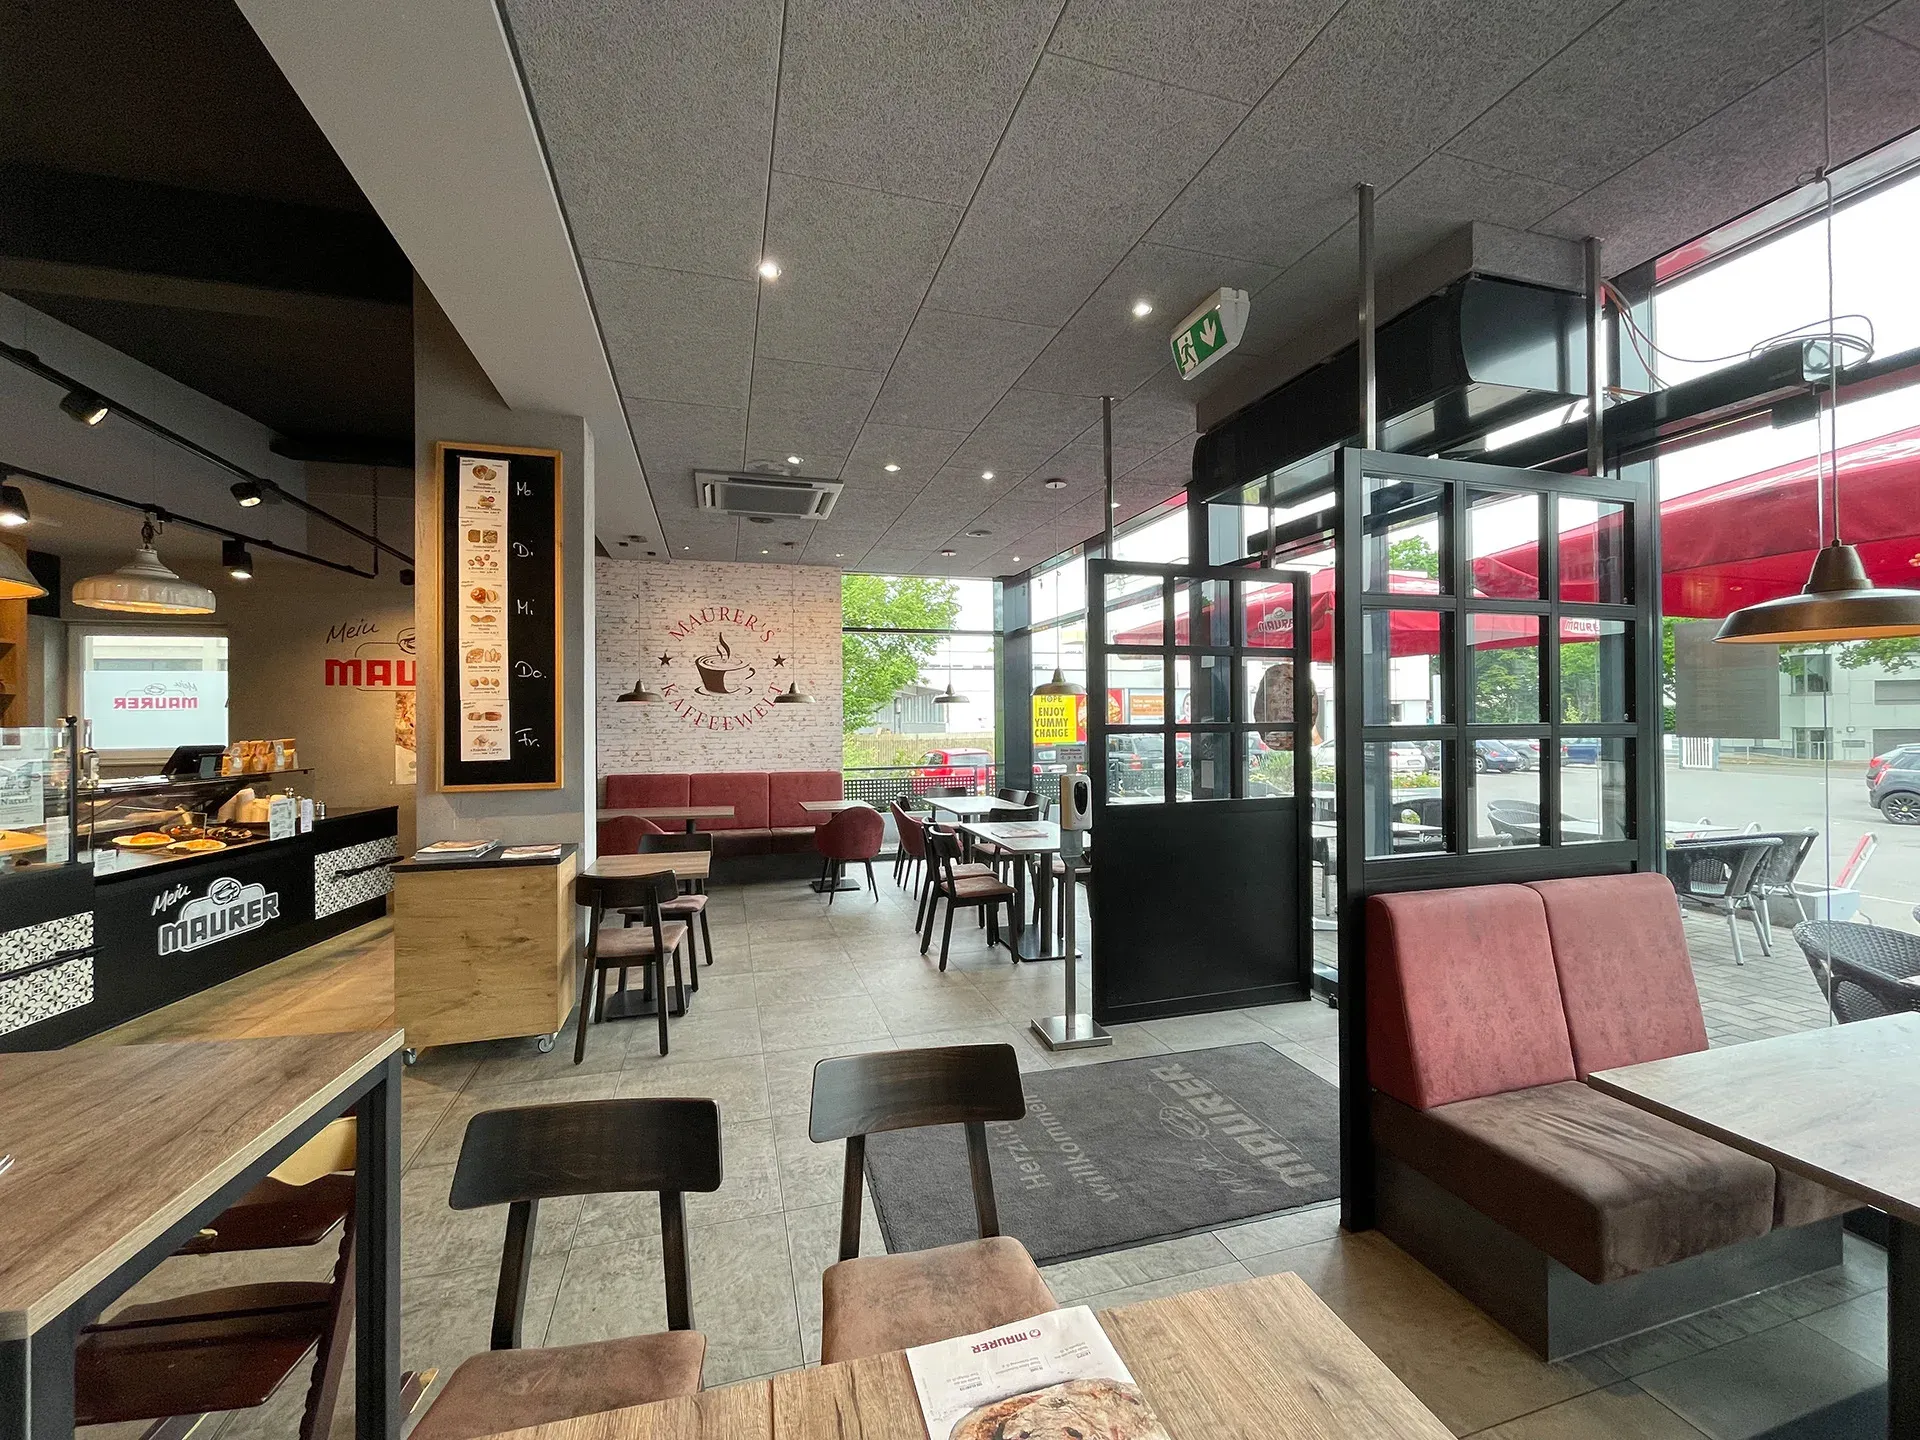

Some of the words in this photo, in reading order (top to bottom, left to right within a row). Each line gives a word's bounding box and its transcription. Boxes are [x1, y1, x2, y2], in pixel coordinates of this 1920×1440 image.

[326, 618, 380, 644] Mein
[668, 606, 776, 643] MAURER'S
[325, 659, 416, 687] MAU
[515, 660, 547, 679] Do.
[661, 682, 784, 731] KAFFEEWELT
[1038, 707, 1065, 716] ENJOY
[1034, 718, 1068, 727] YUMMY
[1034, 728, 1069, 738] CHANGE
[515, 728, 541, 747] Fr.
[151, 884, 191, 916] Mein
[160, 893, 279, 955] MAURER
[1150, 1063, 1331, 1188] MAURER
[971, 1331, 1028, 1354] MAURER
